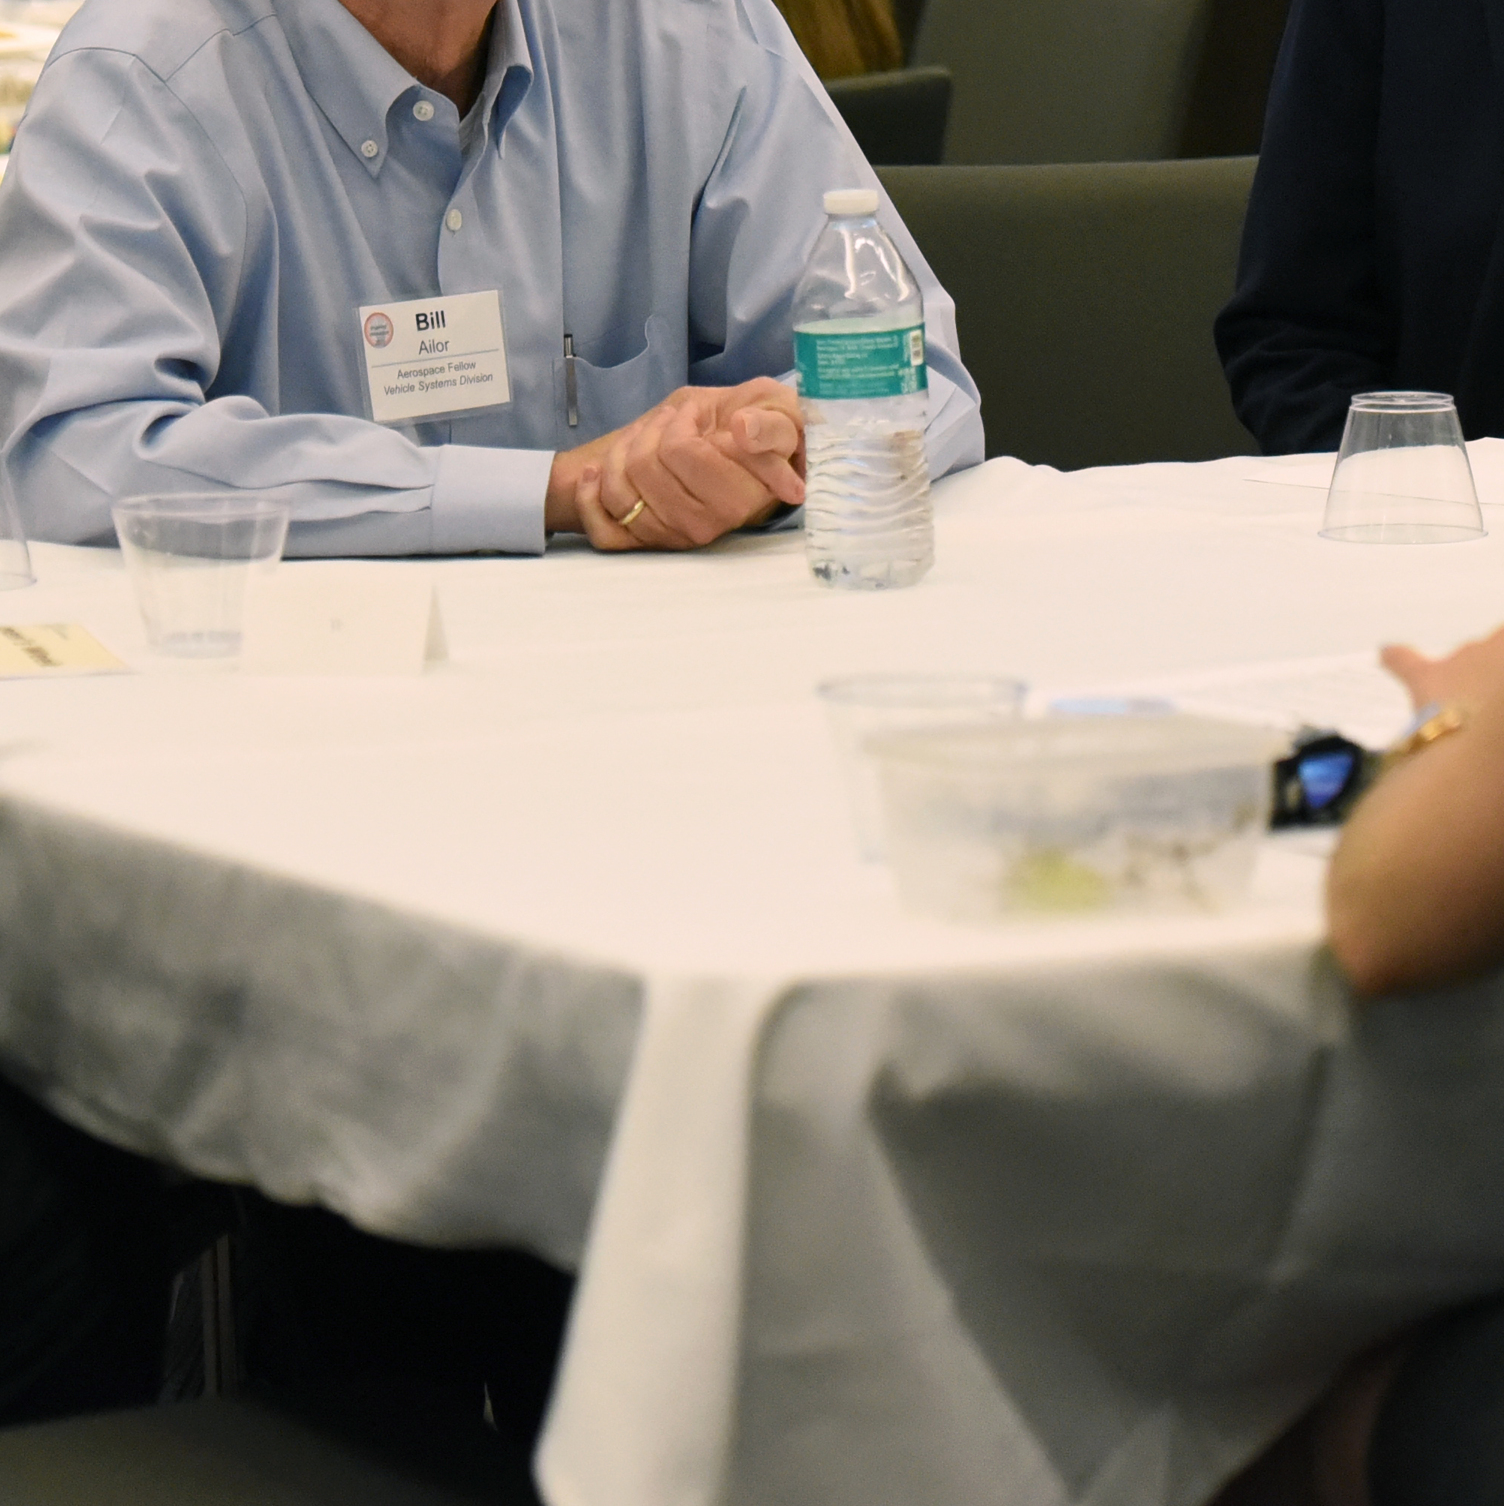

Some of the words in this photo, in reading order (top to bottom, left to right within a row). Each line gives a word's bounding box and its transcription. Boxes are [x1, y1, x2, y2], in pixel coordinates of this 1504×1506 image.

[415, 310, 446, 331] Bill
[418, 339, 450, 355] Ailor
[397, 367, 445, 380] Aerospace
[447, 361, 476, 372] Fellow
[384, 383, 415, 396] Vehicle
[418, 378, 457, 393] Systems
[459, 373, 493, 386] Division
